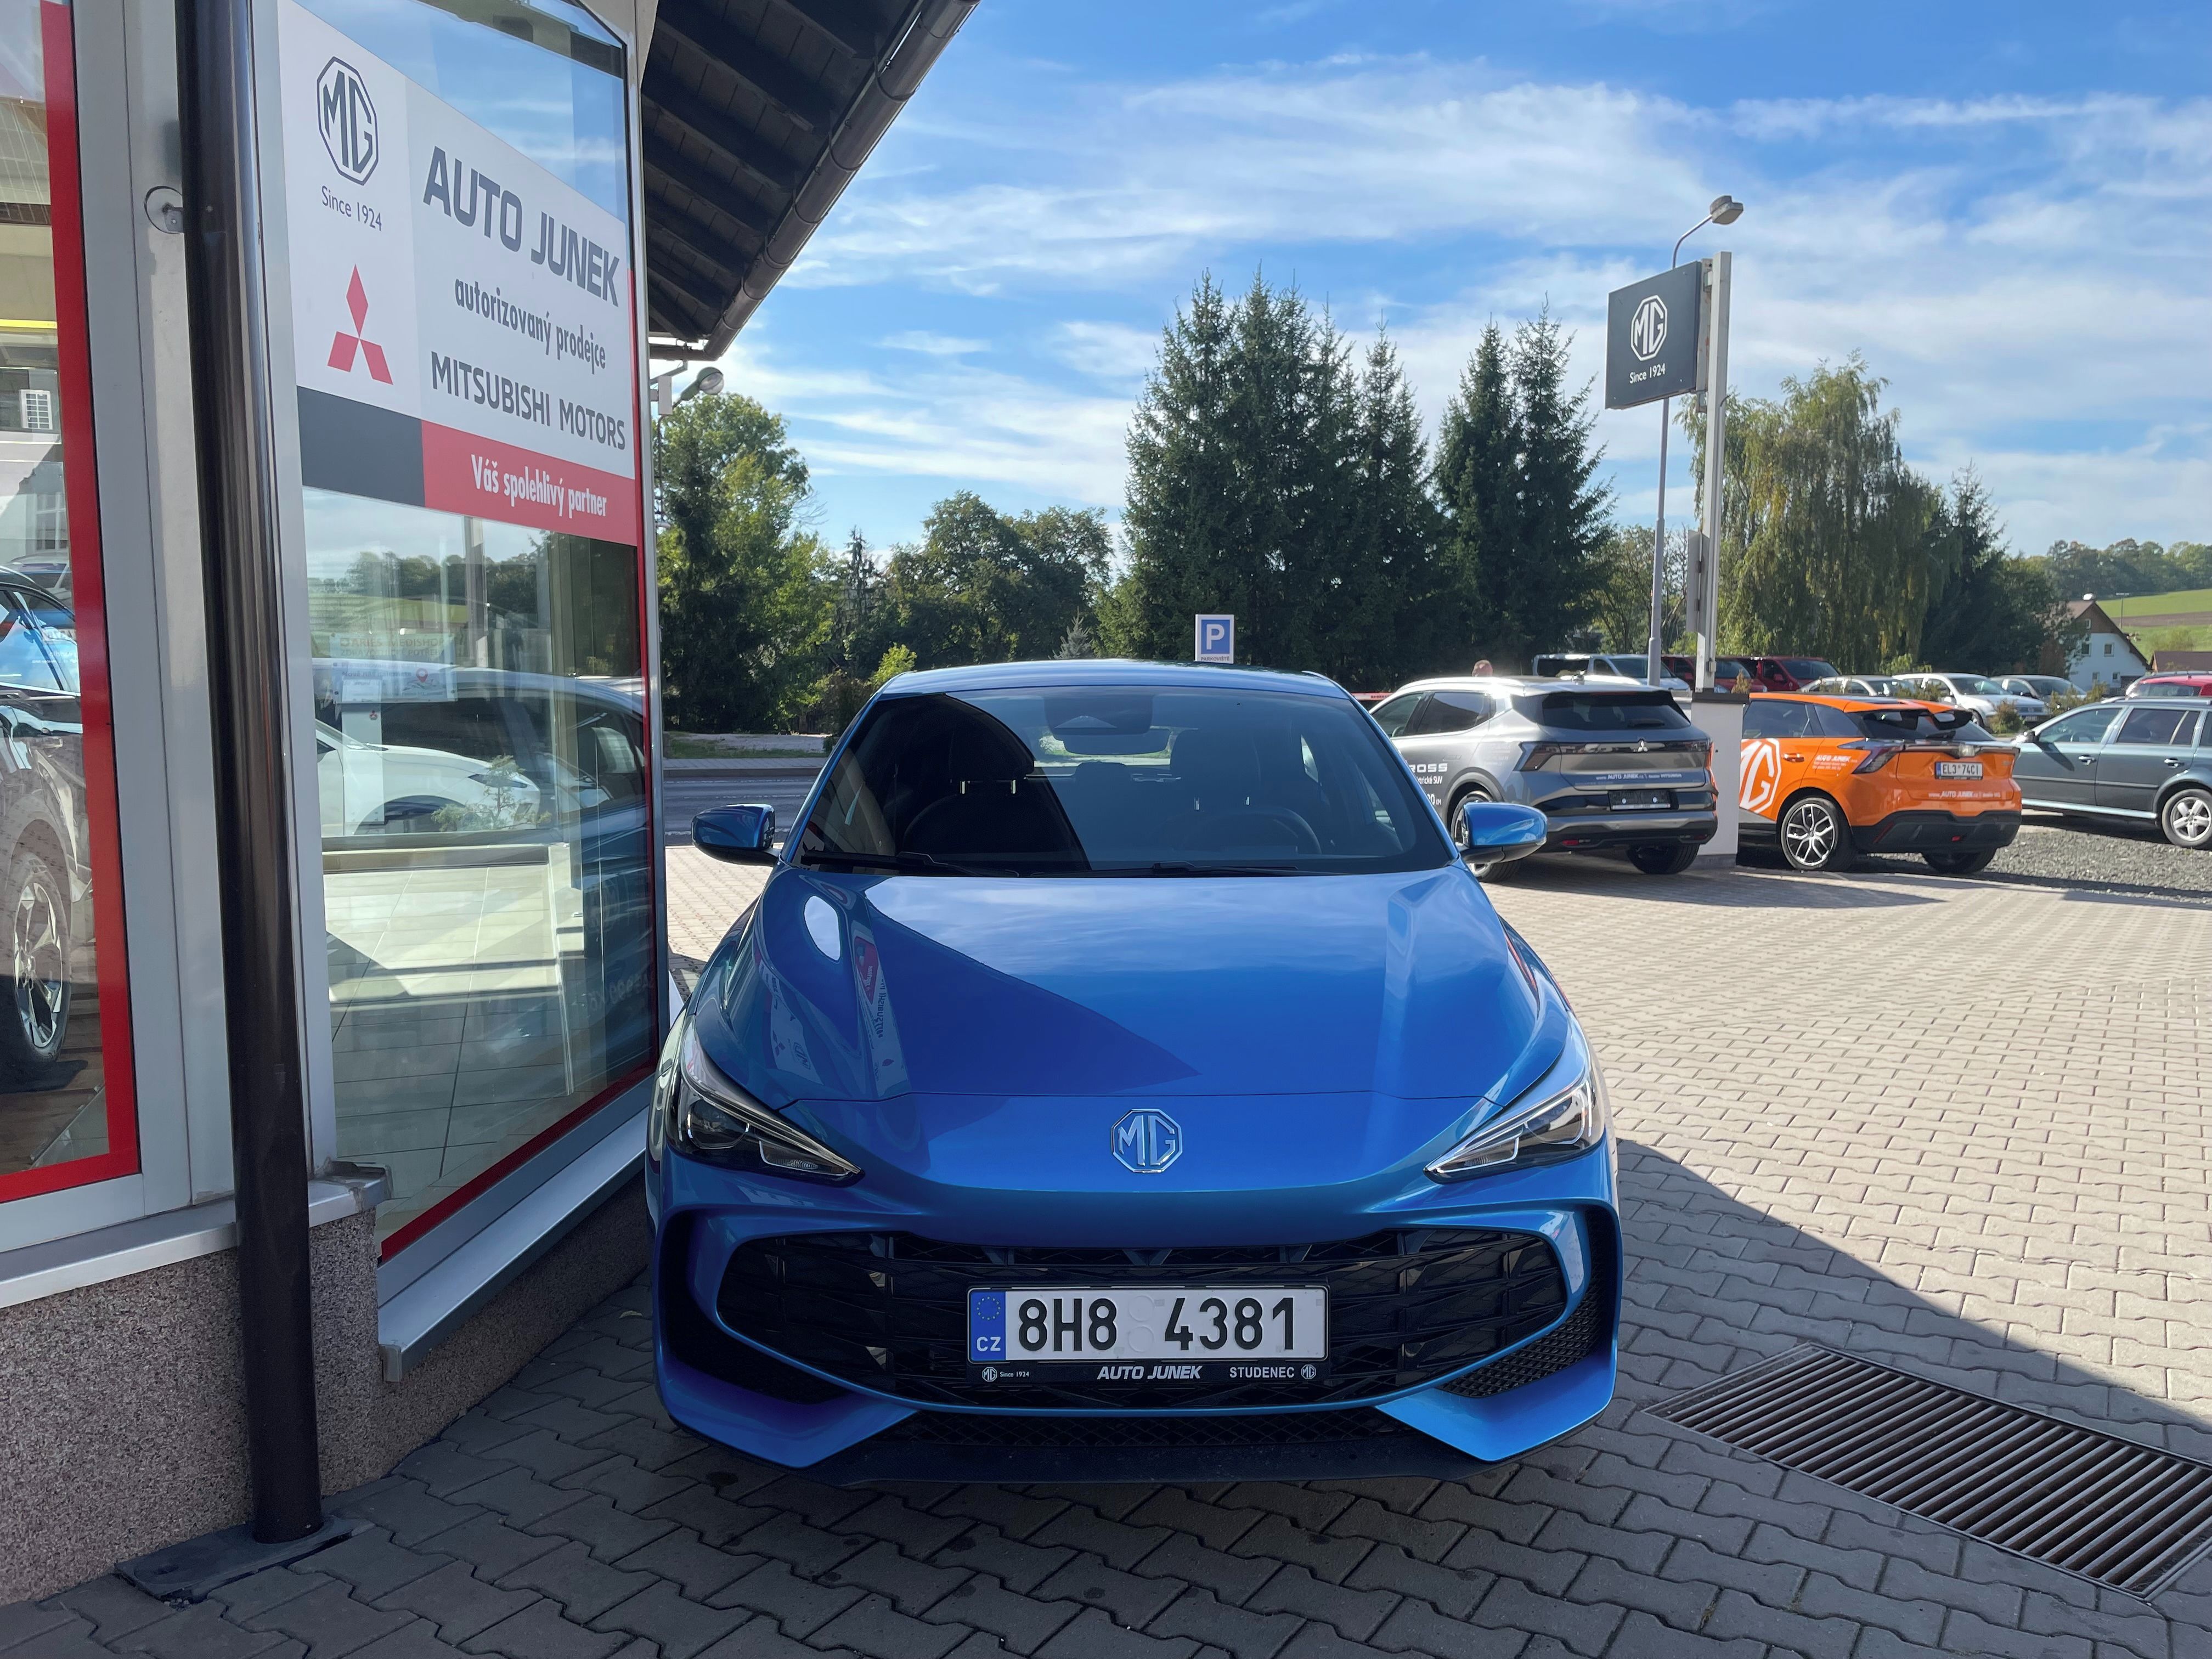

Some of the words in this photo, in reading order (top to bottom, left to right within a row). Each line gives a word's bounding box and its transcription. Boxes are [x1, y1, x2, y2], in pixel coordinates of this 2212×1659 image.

[323, 69, 374, 174] MG
[321, 185, 352, 217] Since
[357, 201, 382, 232] 1924
[423, 145, 522, 252] AUTO
[531, 211, 619, 307] JUNEK
[455, 278, 551, 356] autorizovaný
[556, 324, 606, 375] prodejce
[1633, 300, 1665, 356] MG
[1629, 371, 1647, 385] Since
[1649, 362, 1666, 379] 1924
[431, 351, 550, 427] MITSUBISHI
[559, 398, 626, 450] MOTORS
[471, 454, 499, 494] Váš
[503, 466, 565, 517] spolehlivý
[568, 487, 607, 519] partner
[1206, 624, 1225, 650] P
[1432, 775, 1443, 785] SUV
[1943, 764, 1956, 774] EL3
[1117, 1114, 1176, 1167] MG
[976, 1336, 1001, 1352] CZ
[1018, 1298, 1118, 1351] 8H8
[1164, 1297, 1295, 1351] 4381
[983, 1368, 996, 1381] MG
[1097, 1366, 1144, 1380] AUTO
[1147, 1365, 1203, 1380] JUNEK
[1229, 1367, 1295, 1378] STUDENEC
[1302, 1365, 1316, 1379] MG
